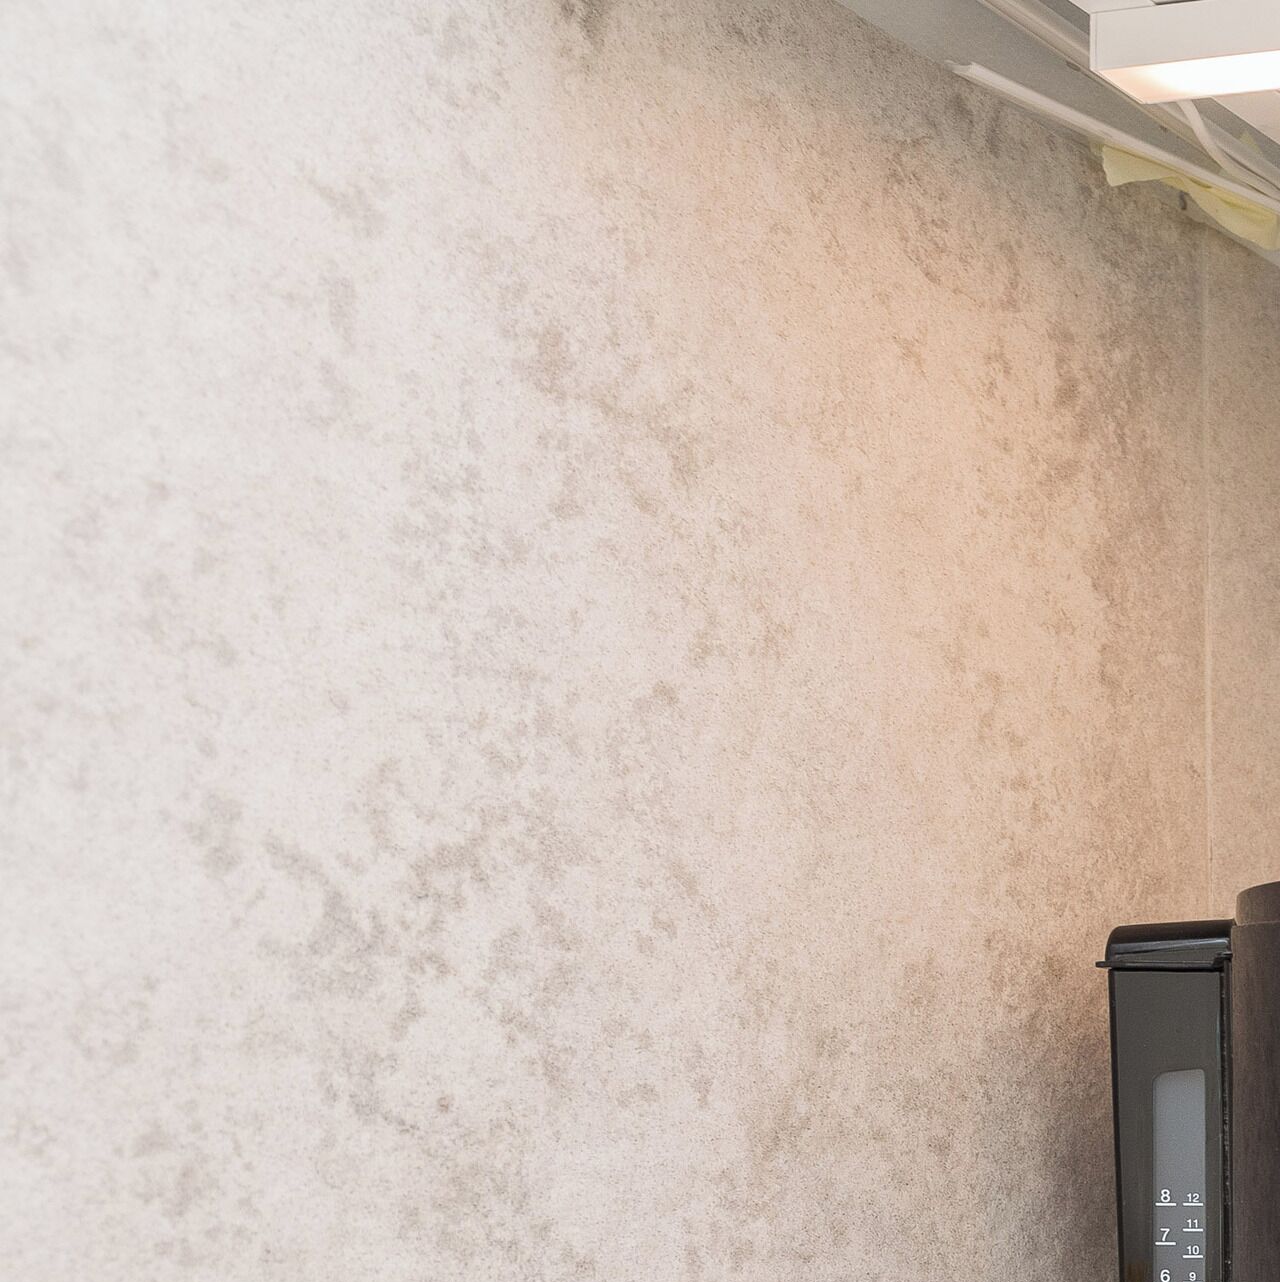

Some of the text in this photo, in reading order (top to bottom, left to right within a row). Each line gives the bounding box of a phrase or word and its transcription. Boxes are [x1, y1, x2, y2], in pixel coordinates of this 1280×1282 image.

[1160, 1188, 1171, 1203] 8
[1186, 1192, 1200, 1203] 12
[1186, 1218, 1199, 1229] 11
[1160, 1227, 1170, 1242] 7
[1186, 1245, 1200, 1255] 10
[1160, 1269, 1171, 1282] 6
[1188, 1271, 1197, 1282] 9
